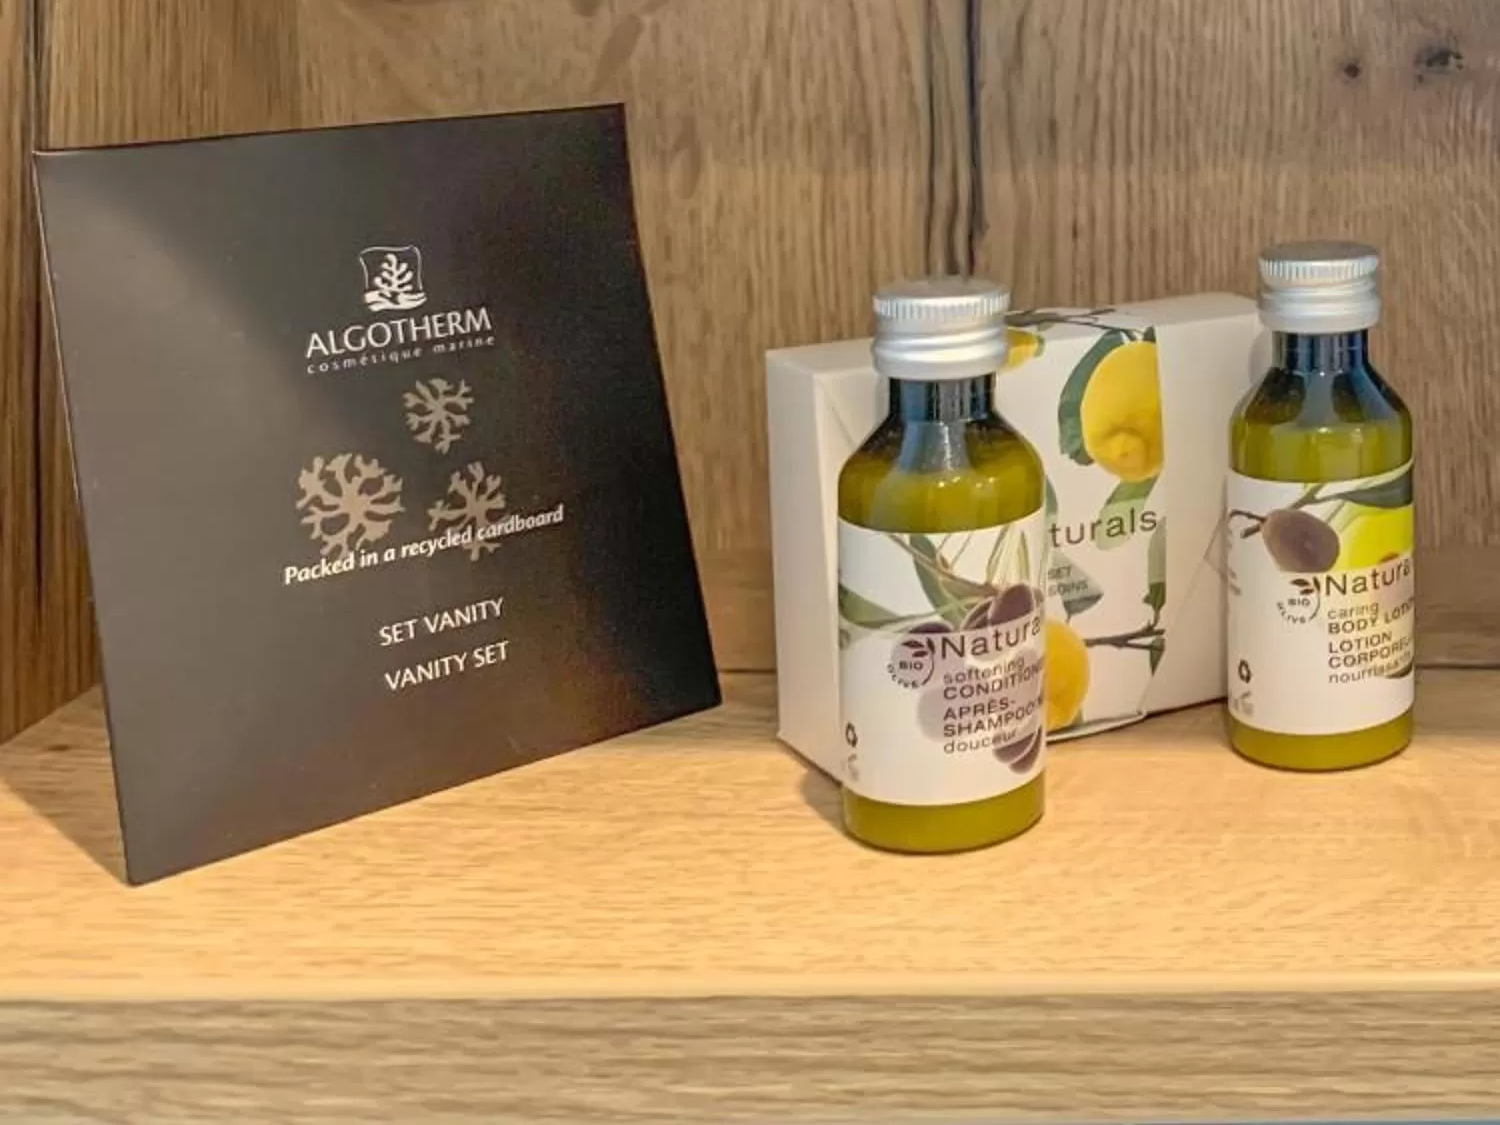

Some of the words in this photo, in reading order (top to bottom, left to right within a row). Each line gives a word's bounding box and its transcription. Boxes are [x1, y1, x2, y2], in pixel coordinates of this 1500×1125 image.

[305, 306, 493, 359] ALGOTHERM
[306, 347, 423, 375] cosmétique
[432, 335, 496, 354] marine
[283, 549, 356, 586] Packed
[359, 550, 379, 568] in
[383, 547, 396, 562] a
[400, 524, 473, 559] recycled
[476, 503, 565, 542] cardboard
[379, 618, 418, 647] SET
[423, 596, 505, 635] VANITY
[1327, 602, 1379, 620] caring
[1328, 617, 1379, 635] BODY
[1328, 631, 1393, 654] LOTION
[384, 651, 468, 691] VANITY
[474, 640, 510, 669] SET
[899, 660, 924, 671] BIO
[943, 656, 1025, 685] softening
[943, 729, 1018, 754] douceur
